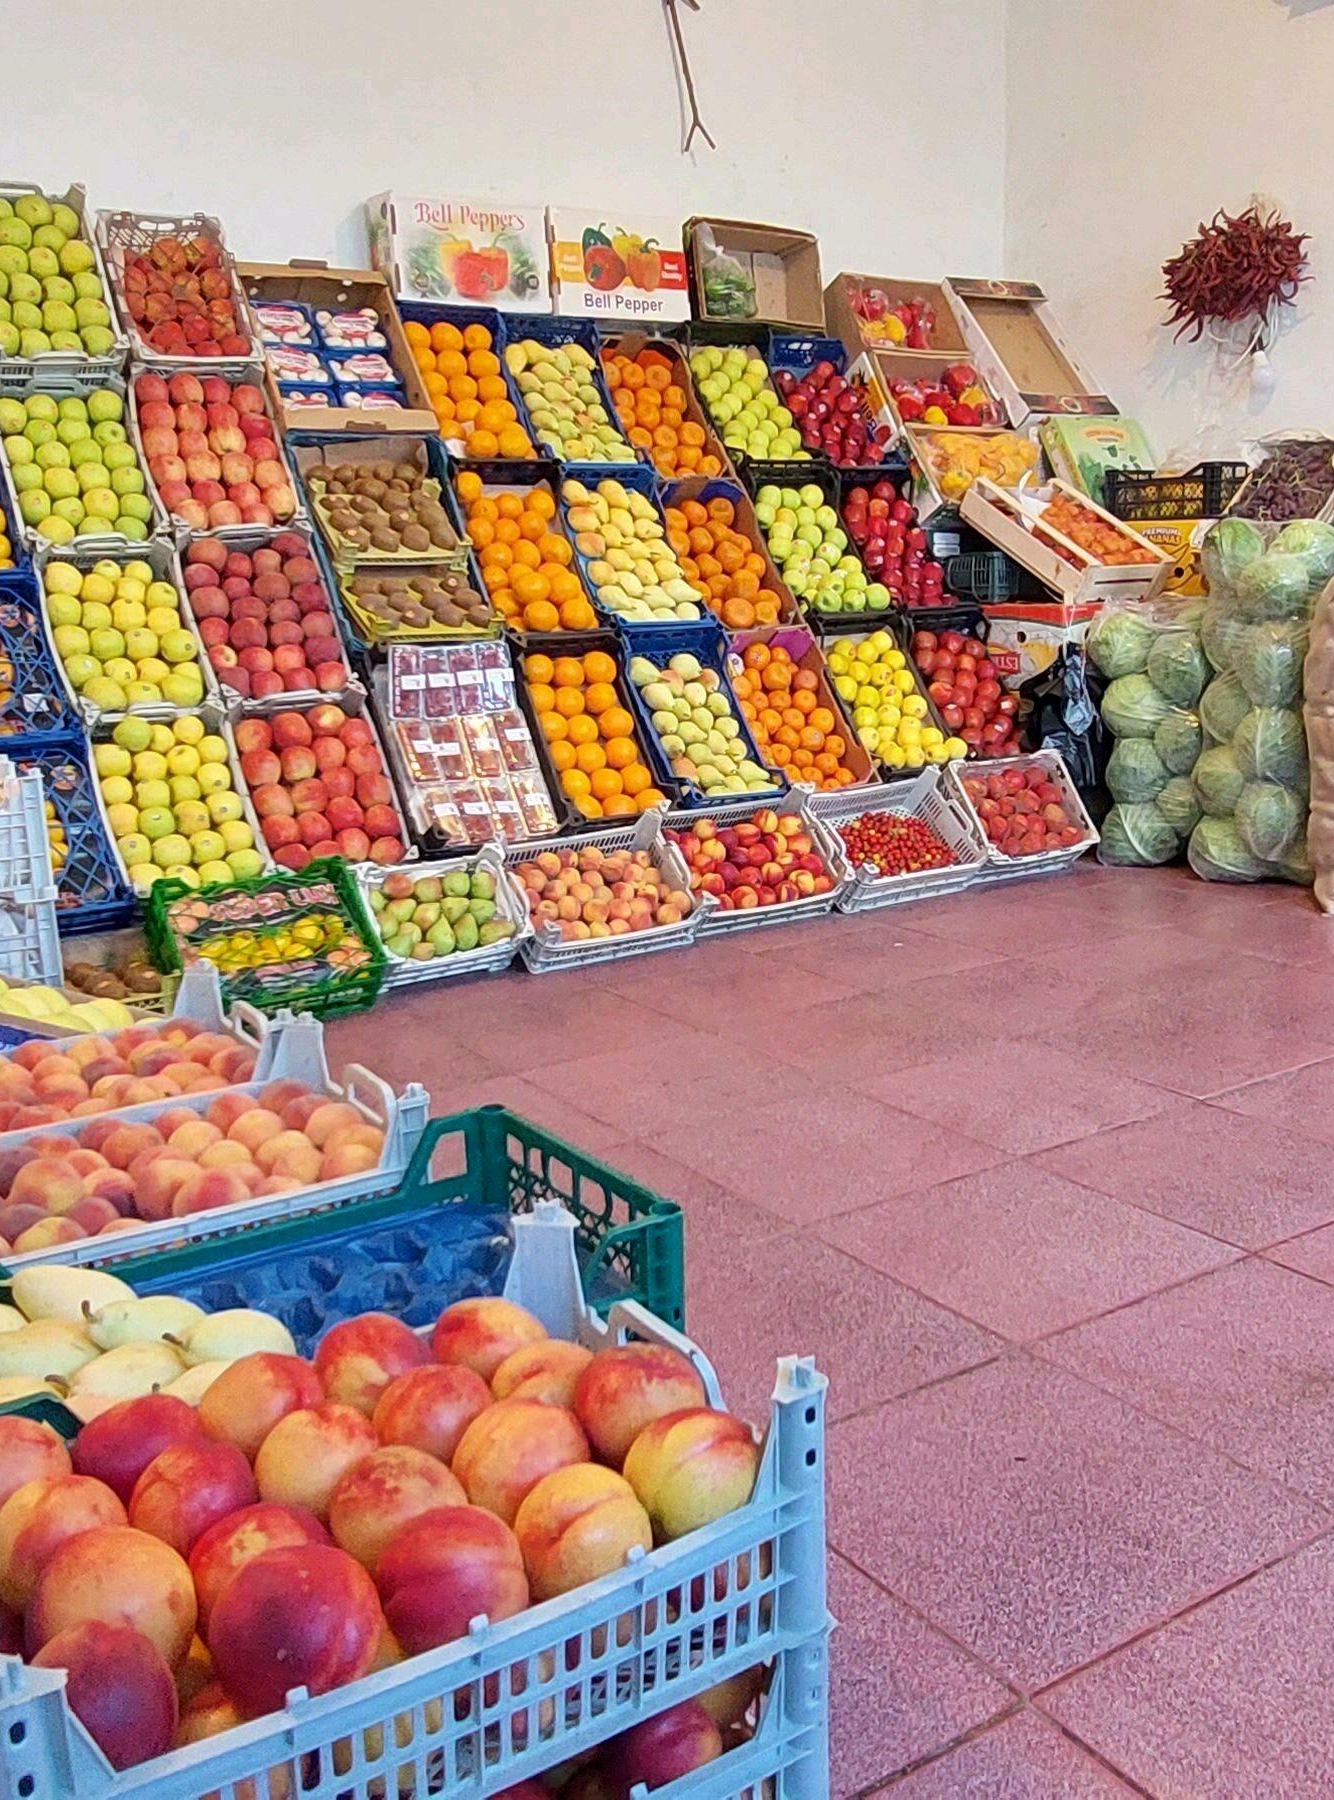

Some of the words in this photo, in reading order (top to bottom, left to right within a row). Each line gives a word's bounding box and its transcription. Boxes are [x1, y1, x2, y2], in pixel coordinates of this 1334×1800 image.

[413, 202, 450, 231] Bell
[459, 204, 525, 232] Peppers
[583, 293, 611, 309] Bell
[615, 295, 664, 314] Pepper
[1147, 534, 1181, 545] NANAS
